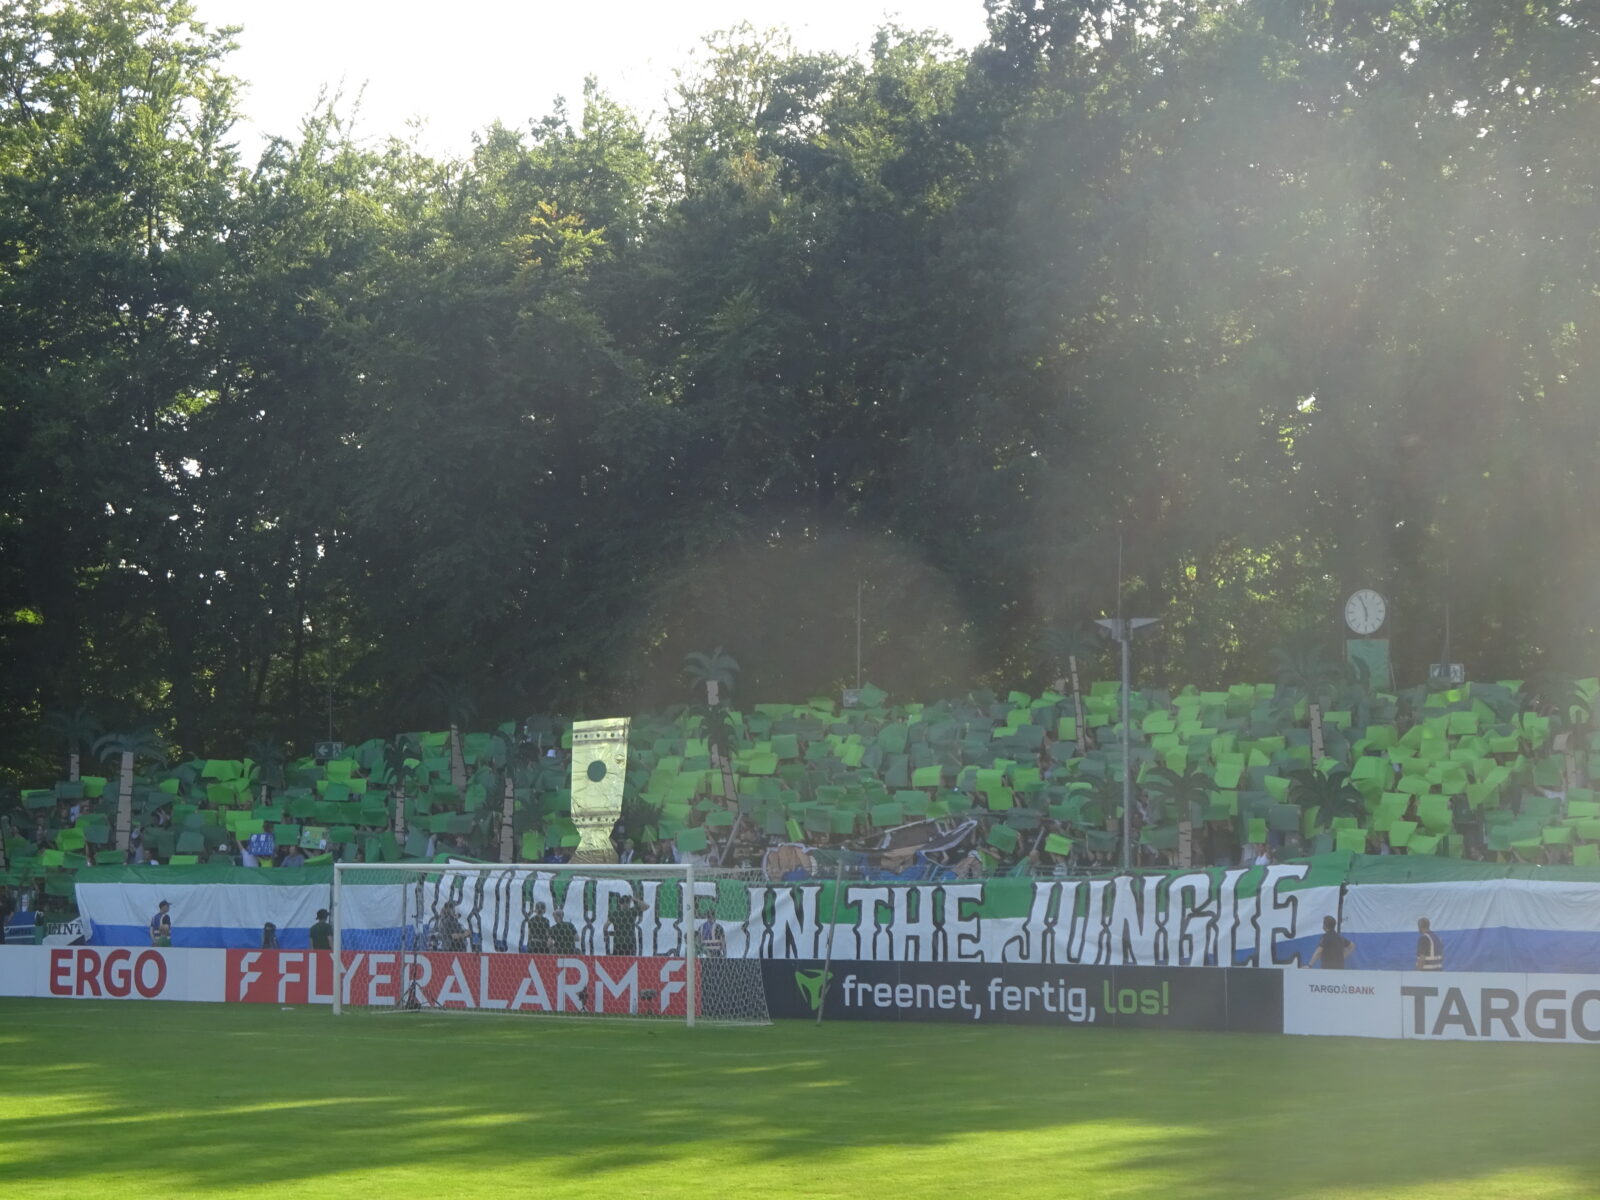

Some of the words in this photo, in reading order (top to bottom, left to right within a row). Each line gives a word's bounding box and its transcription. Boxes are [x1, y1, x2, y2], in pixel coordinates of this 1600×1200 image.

[742, 883, 824, 960] IN
[847, 882, 985, 963] THE
[1002, 862, 1311, 968] JUNGLE
[50, 948, 167, 998] ERGO
[278, 952, 639, 1015] FLYERALARM
[843, 975, 981, 1020] freenet,
[988, 978, 1096, 1023] fertig,
[1104, 981, 1169, 1016] los!
[1400, 986, 1600, 1041] TARGO
